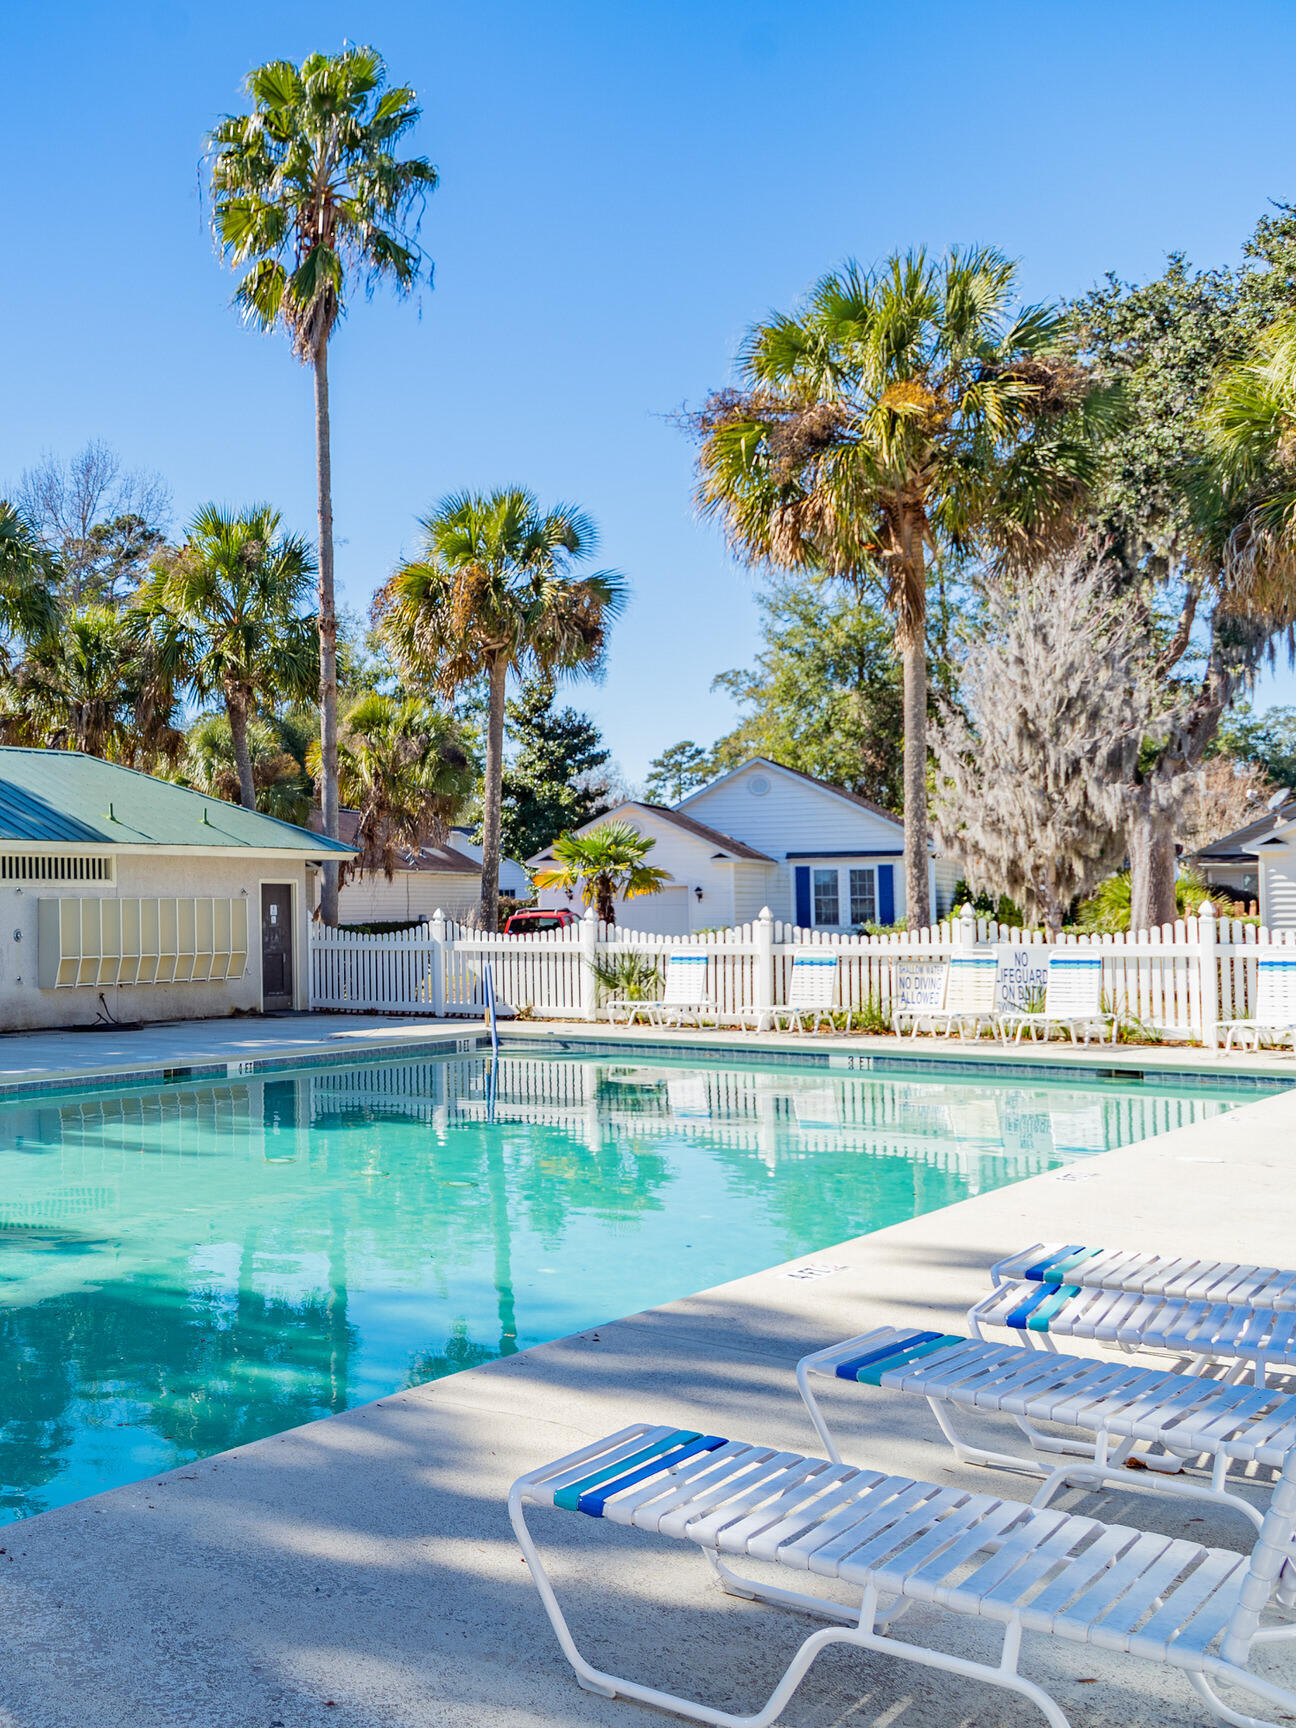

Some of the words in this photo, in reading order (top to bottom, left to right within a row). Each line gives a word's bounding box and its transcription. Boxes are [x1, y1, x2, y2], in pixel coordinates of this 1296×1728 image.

[1014, 951, 1029, 967] NO
[899, 976, 912, 989] NO
[914, 976, 942, 990] DIVING
[900, 991, 940, 1005] ALLOWED
[1001, 985, 1015, 1000] ON
